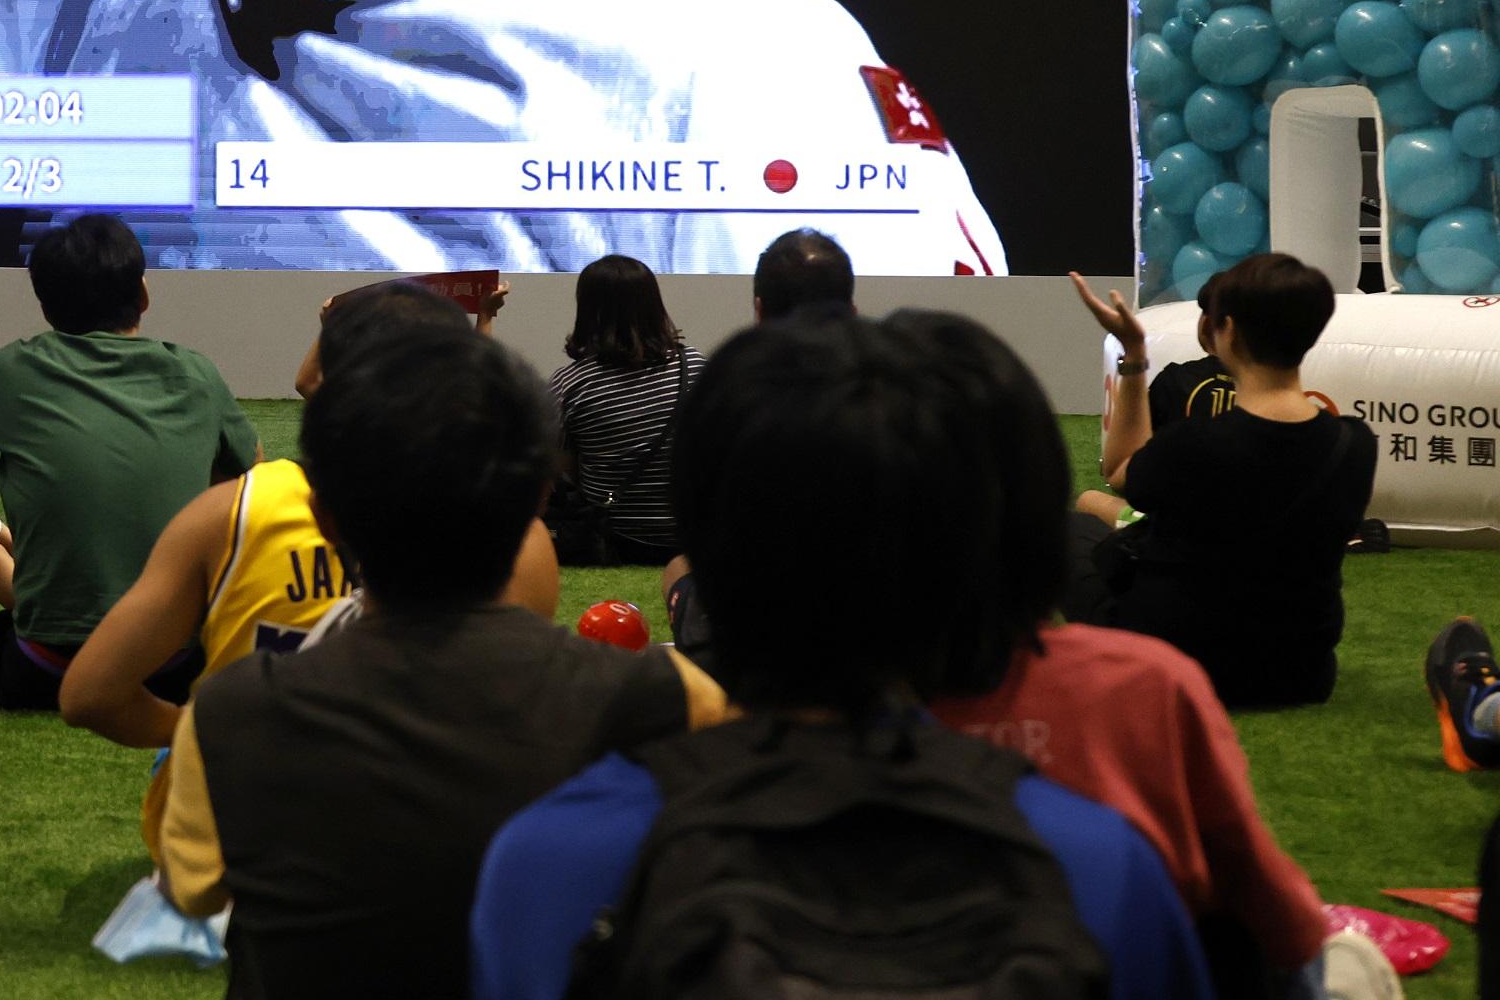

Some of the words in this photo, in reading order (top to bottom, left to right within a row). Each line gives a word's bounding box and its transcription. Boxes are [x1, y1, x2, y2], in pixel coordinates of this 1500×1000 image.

[1, 157, 62, 199] 2/3
[229, 159, 270, 189] 14
[521, 160, 683, 192] SHIKINE
[698, 161, 726, 192] T.
[835, 163, 907, 191] JPN
[1353, 399, 1419, 425] SINO
[1376, 432, 1497, 467] 和集團
